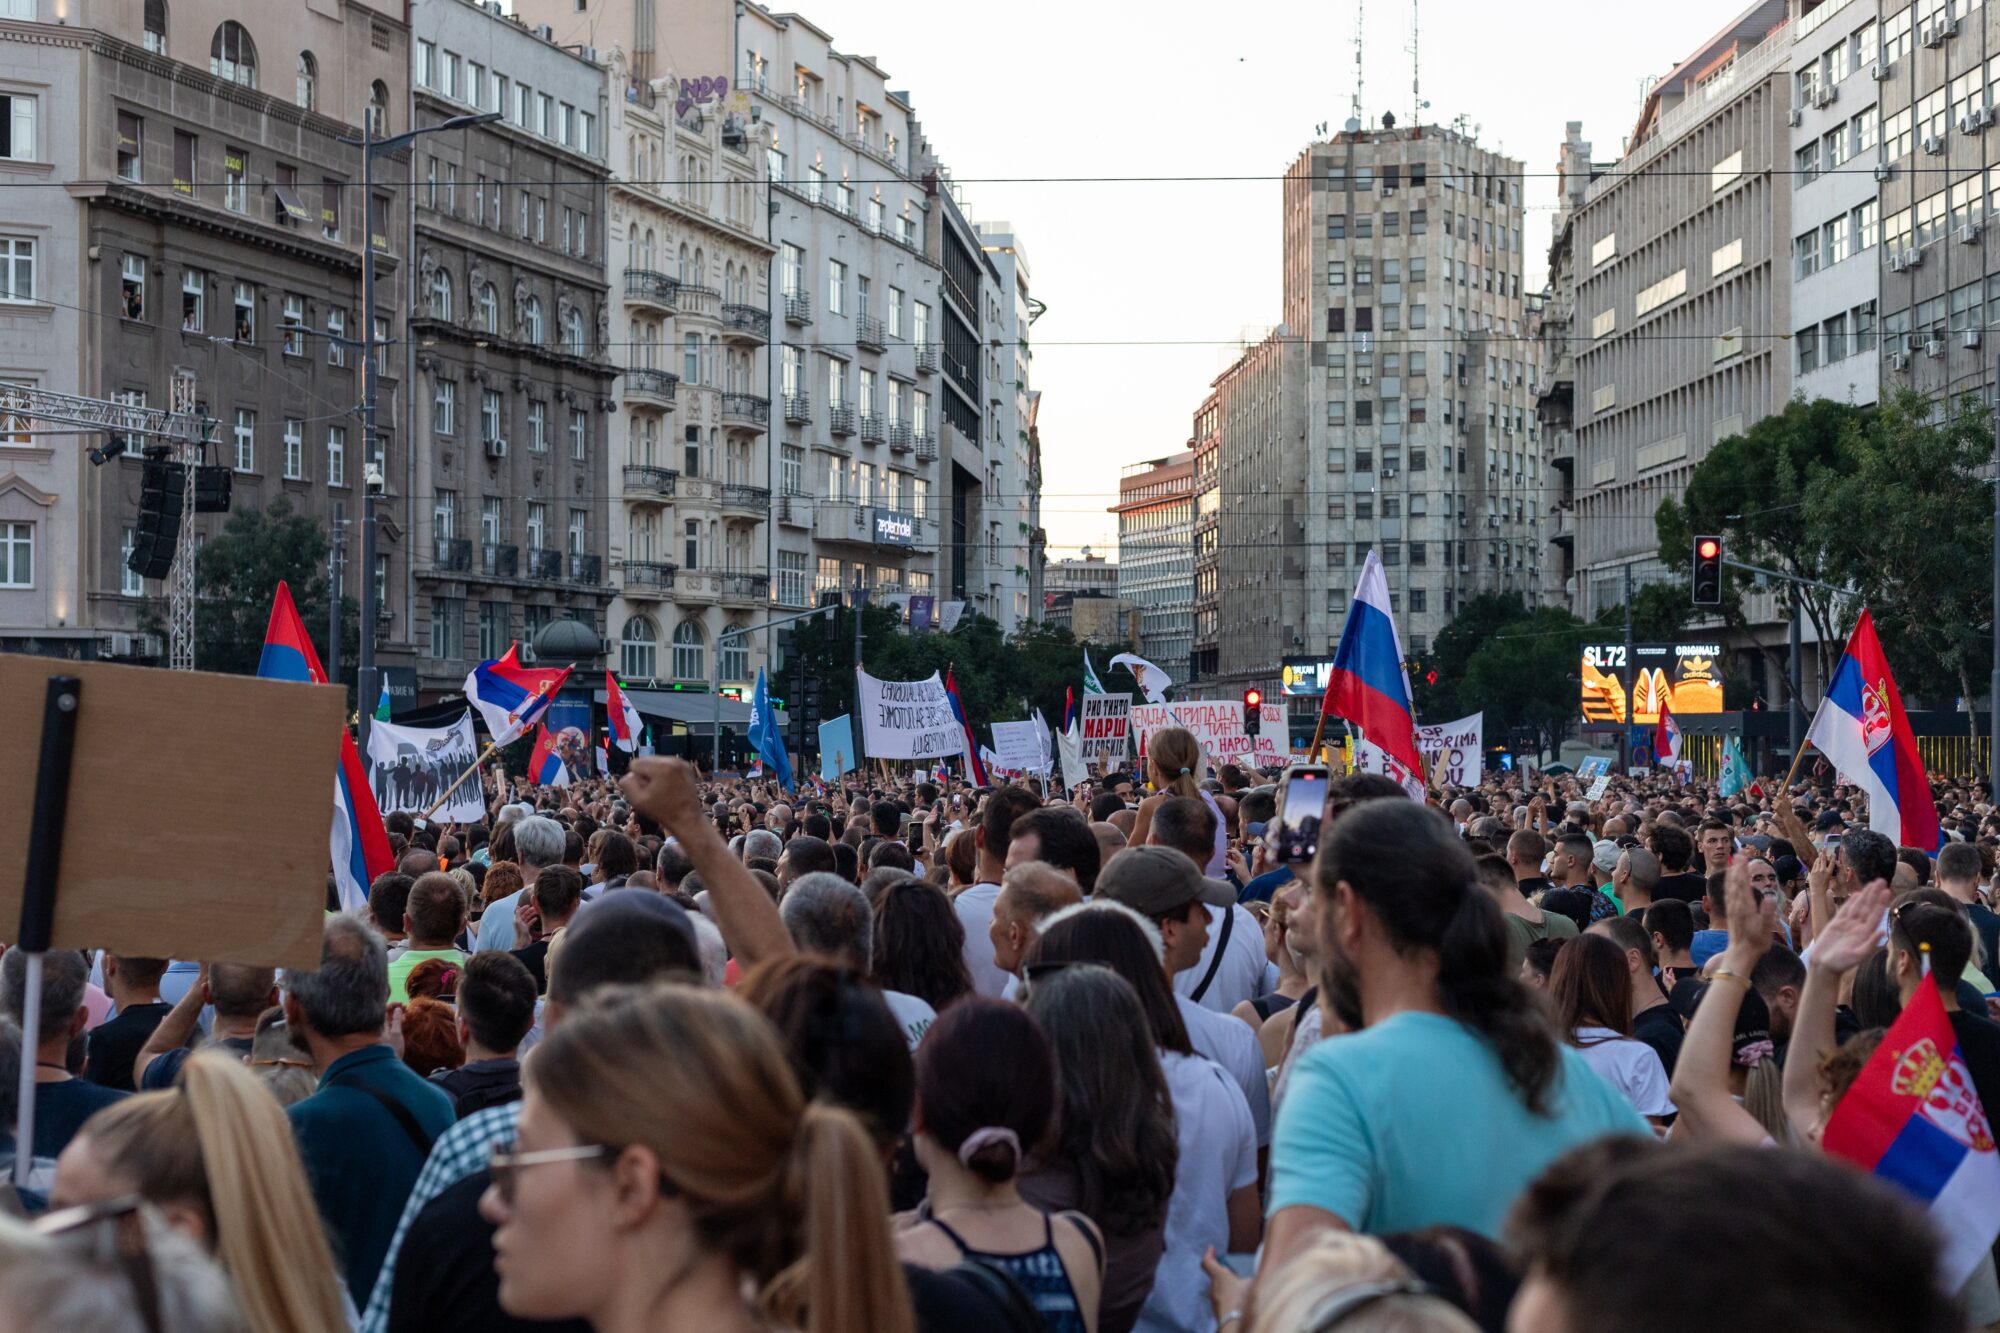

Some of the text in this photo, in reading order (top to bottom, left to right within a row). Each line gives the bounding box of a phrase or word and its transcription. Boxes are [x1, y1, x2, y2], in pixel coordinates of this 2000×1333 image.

[1675, 645, 1720, 656] ORIGINALS
[1317, 663, 1334, 689] M
[1086, 698, 1129, 717] РИО ТИНТО
[1174, 705, 1239, 724] ПРИПАДА
[1084, 717, 1127, 739] МАРШ
[1081, 739, 1093, 758] ИЗ
[1423, 733, 1478, 748] TORIMA
